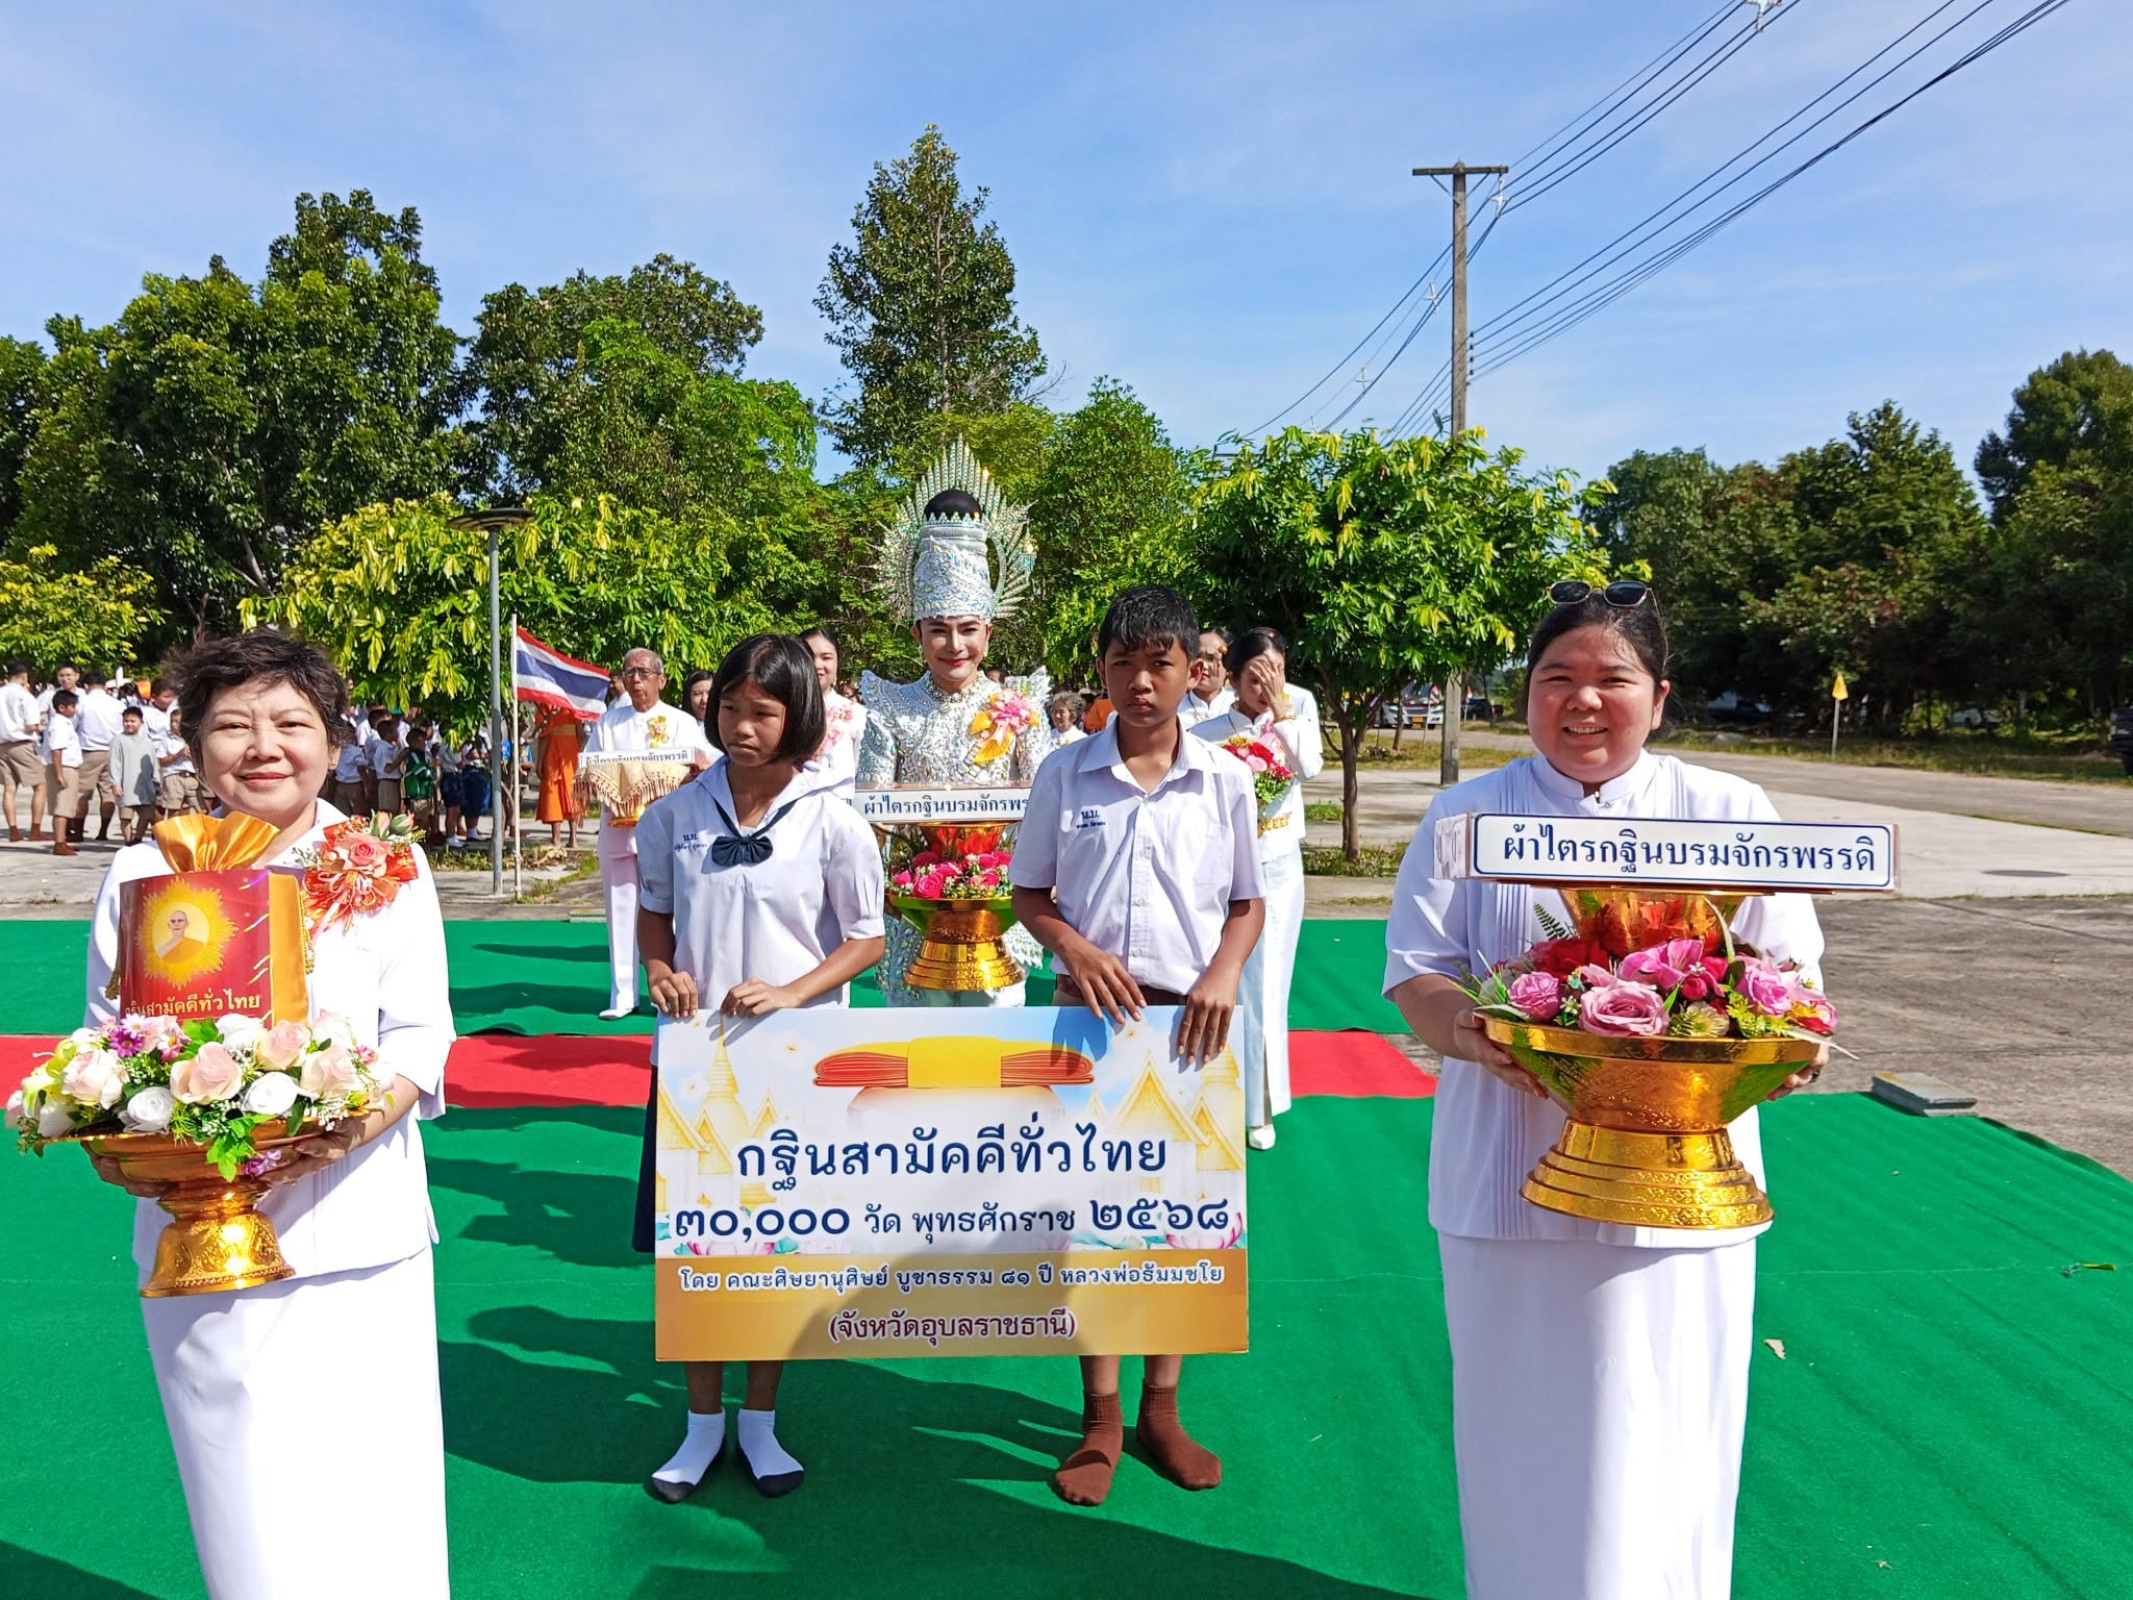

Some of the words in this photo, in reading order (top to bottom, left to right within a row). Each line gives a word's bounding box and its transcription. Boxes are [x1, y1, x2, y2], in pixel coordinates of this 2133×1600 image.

[1503, 822, 1876, 873] ผ้าไตรกฐินบรมจักรพรรดิ
[736, 1111, 1167, 1191] กฐินสามัคคีทั่วไทย
[675, 1207, 850, 1243] ๓๐,๐๐๐
[864, 1203, 901, 1234] วัด
[912, 1201, 1075, 1244] พุทธศักราช
[1089, 1196, 1229, 1231] ๒๕๖๘
[681, 1270, 718, 1288] โดย
[727, 1265, 888, 1292] คณะศิษยานุศิษย์
[896, 1267, 992, 1291] บูชาธรรม
[1001, 1269, 1030, 1285] ๘๑
[1039, 1262, 1052, 1284] ปี
[1060, 1262, 1223, 1284] หลวงพ่อธัมมชโย
[829, 1308, 1077, 1346] (จังหวัดอุบลราชธานี)
